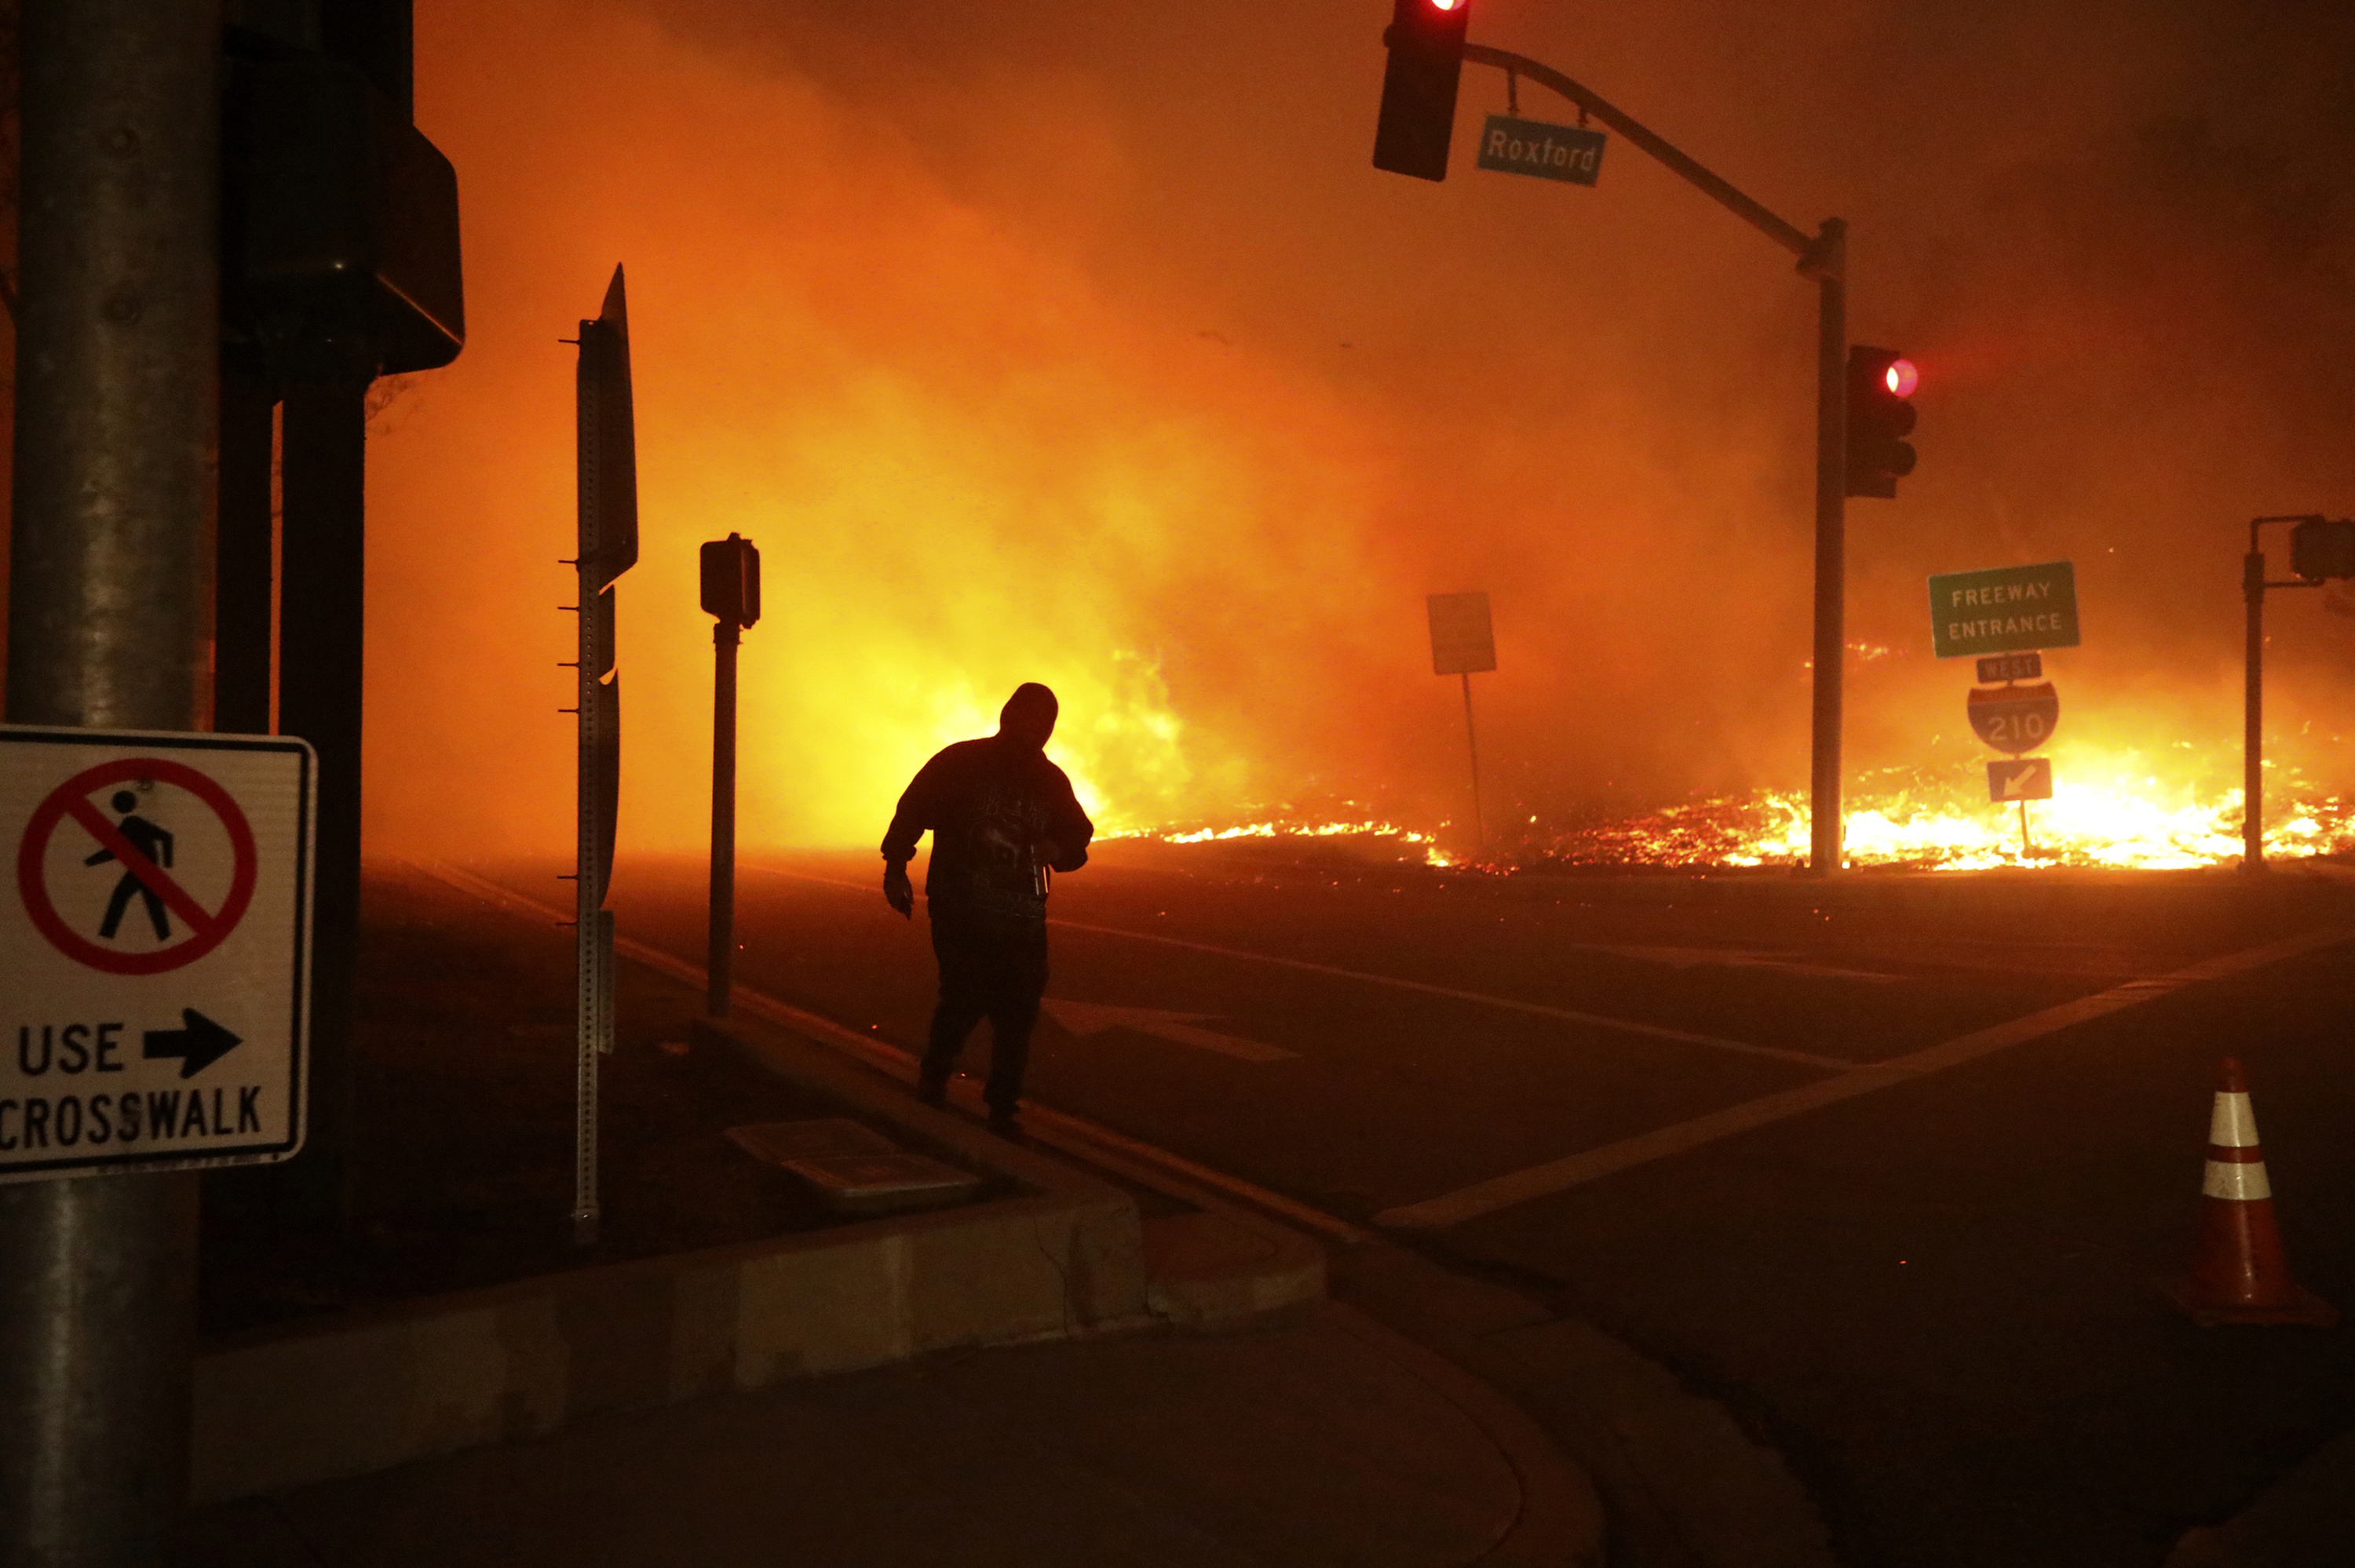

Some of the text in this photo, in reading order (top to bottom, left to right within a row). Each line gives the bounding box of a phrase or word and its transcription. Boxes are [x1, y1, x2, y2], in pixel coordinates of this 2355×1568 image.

[1488, 129, 1597, 172] Roxford
[1952, 582, 2050, 608] FREEWAY
[1948, 613, 2061, 640] ENTRANCE
[1984, 658, 2032, 680] WEST
[1988, 713, 2044, 742] 210
[18, 1023, 125, 1077] USE
[0, 1085, 261, 1151] CROSSWALK
